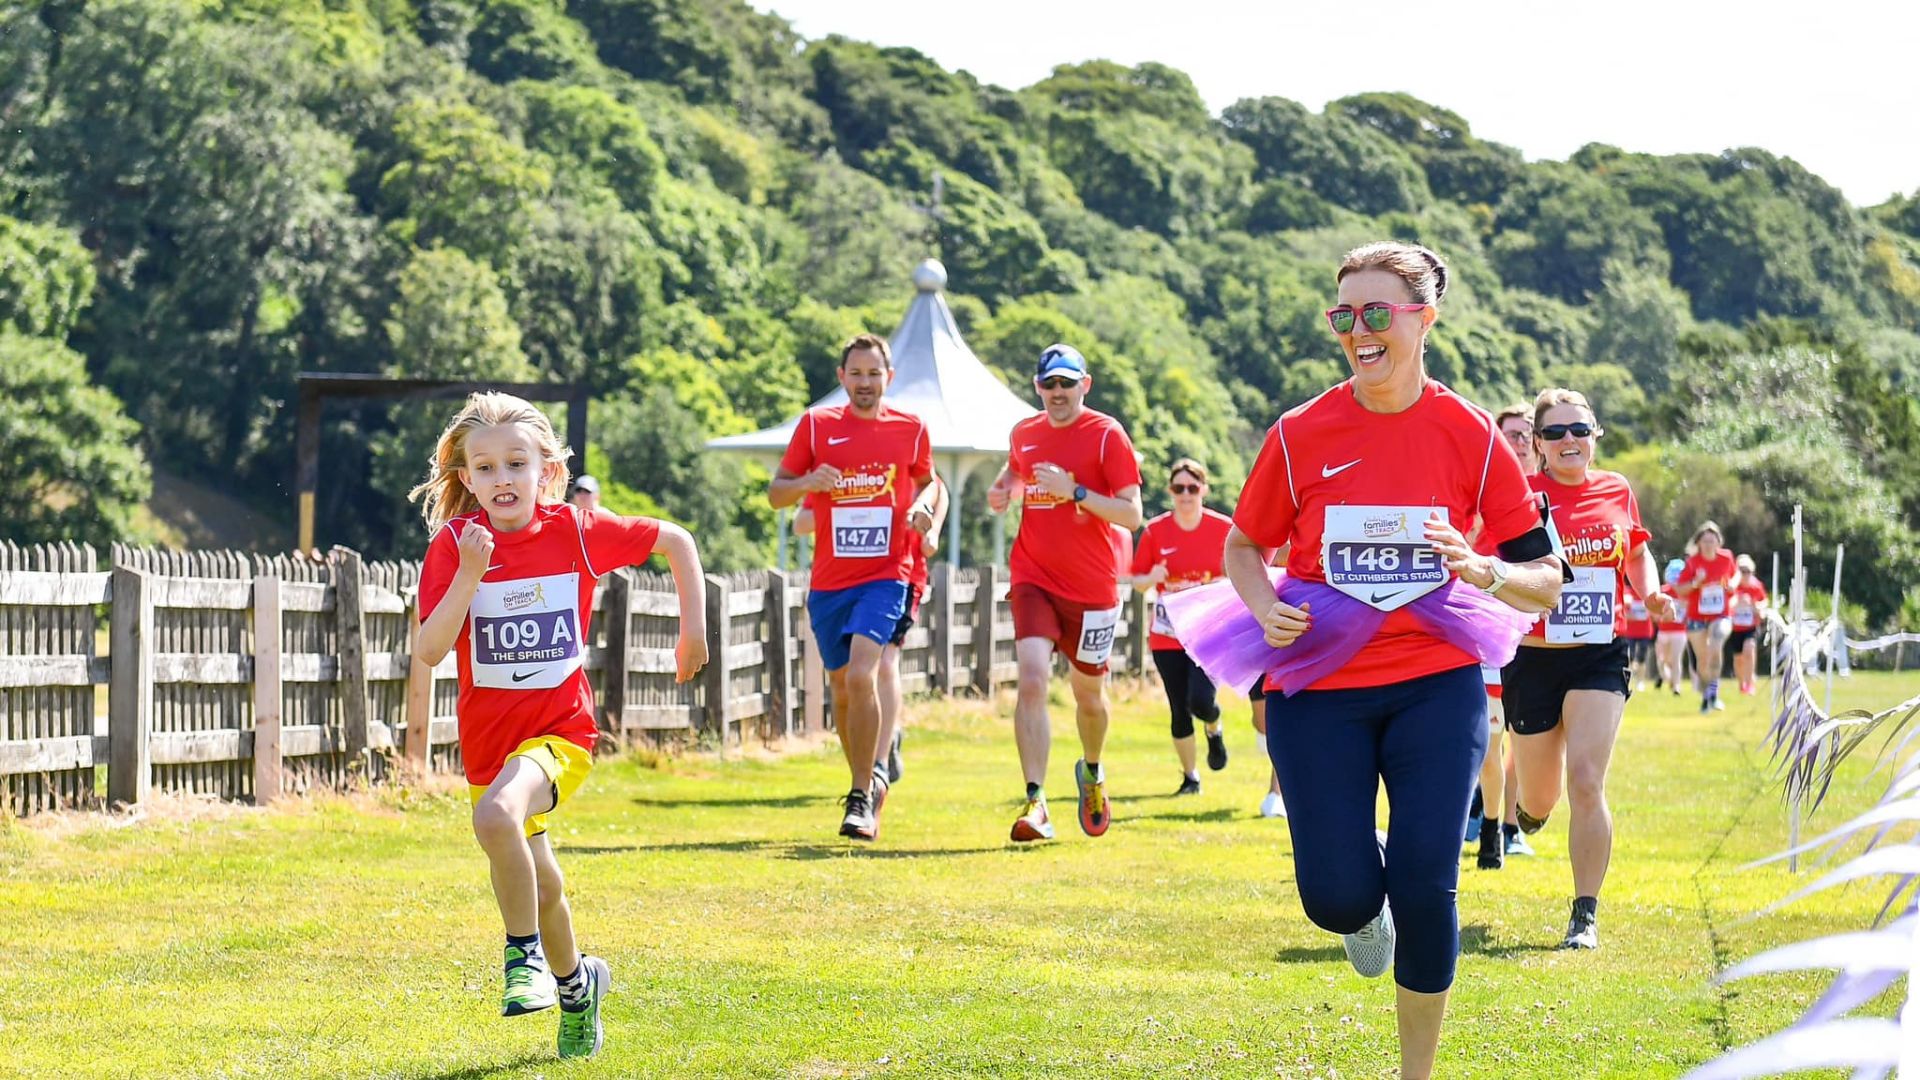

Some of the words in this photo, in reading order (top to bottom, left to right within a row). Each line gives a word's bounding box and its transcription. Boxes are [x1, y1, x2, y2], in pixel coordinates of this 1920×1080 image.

[834, 473, 885, 489] amilies
[1364, 519, 1399, 530] families
[838, 529, 870, 545] 147
[874, 528, 886, 545] A
[1562, 536, 1612, 556] milies
[1337, 546, 1400, 572] 148
[1412, 547, 1436, 570] E
[1333, 572, 1346, 581] ST
[1348, 572, 1409, 582] CUTHBERT'S
[1410, 571, 1442, 580] STARS
[503, 590, 535, 604] families
[1597, 595, 1610, 615] A
[1563, 616, 1603, 624] JOHNSTON
[481, 619, 541, 649] 109
[551, 615, 573, 645] A
[491, 652, 515, 662] THE
[518, 647, 565, 661] SPRITES
